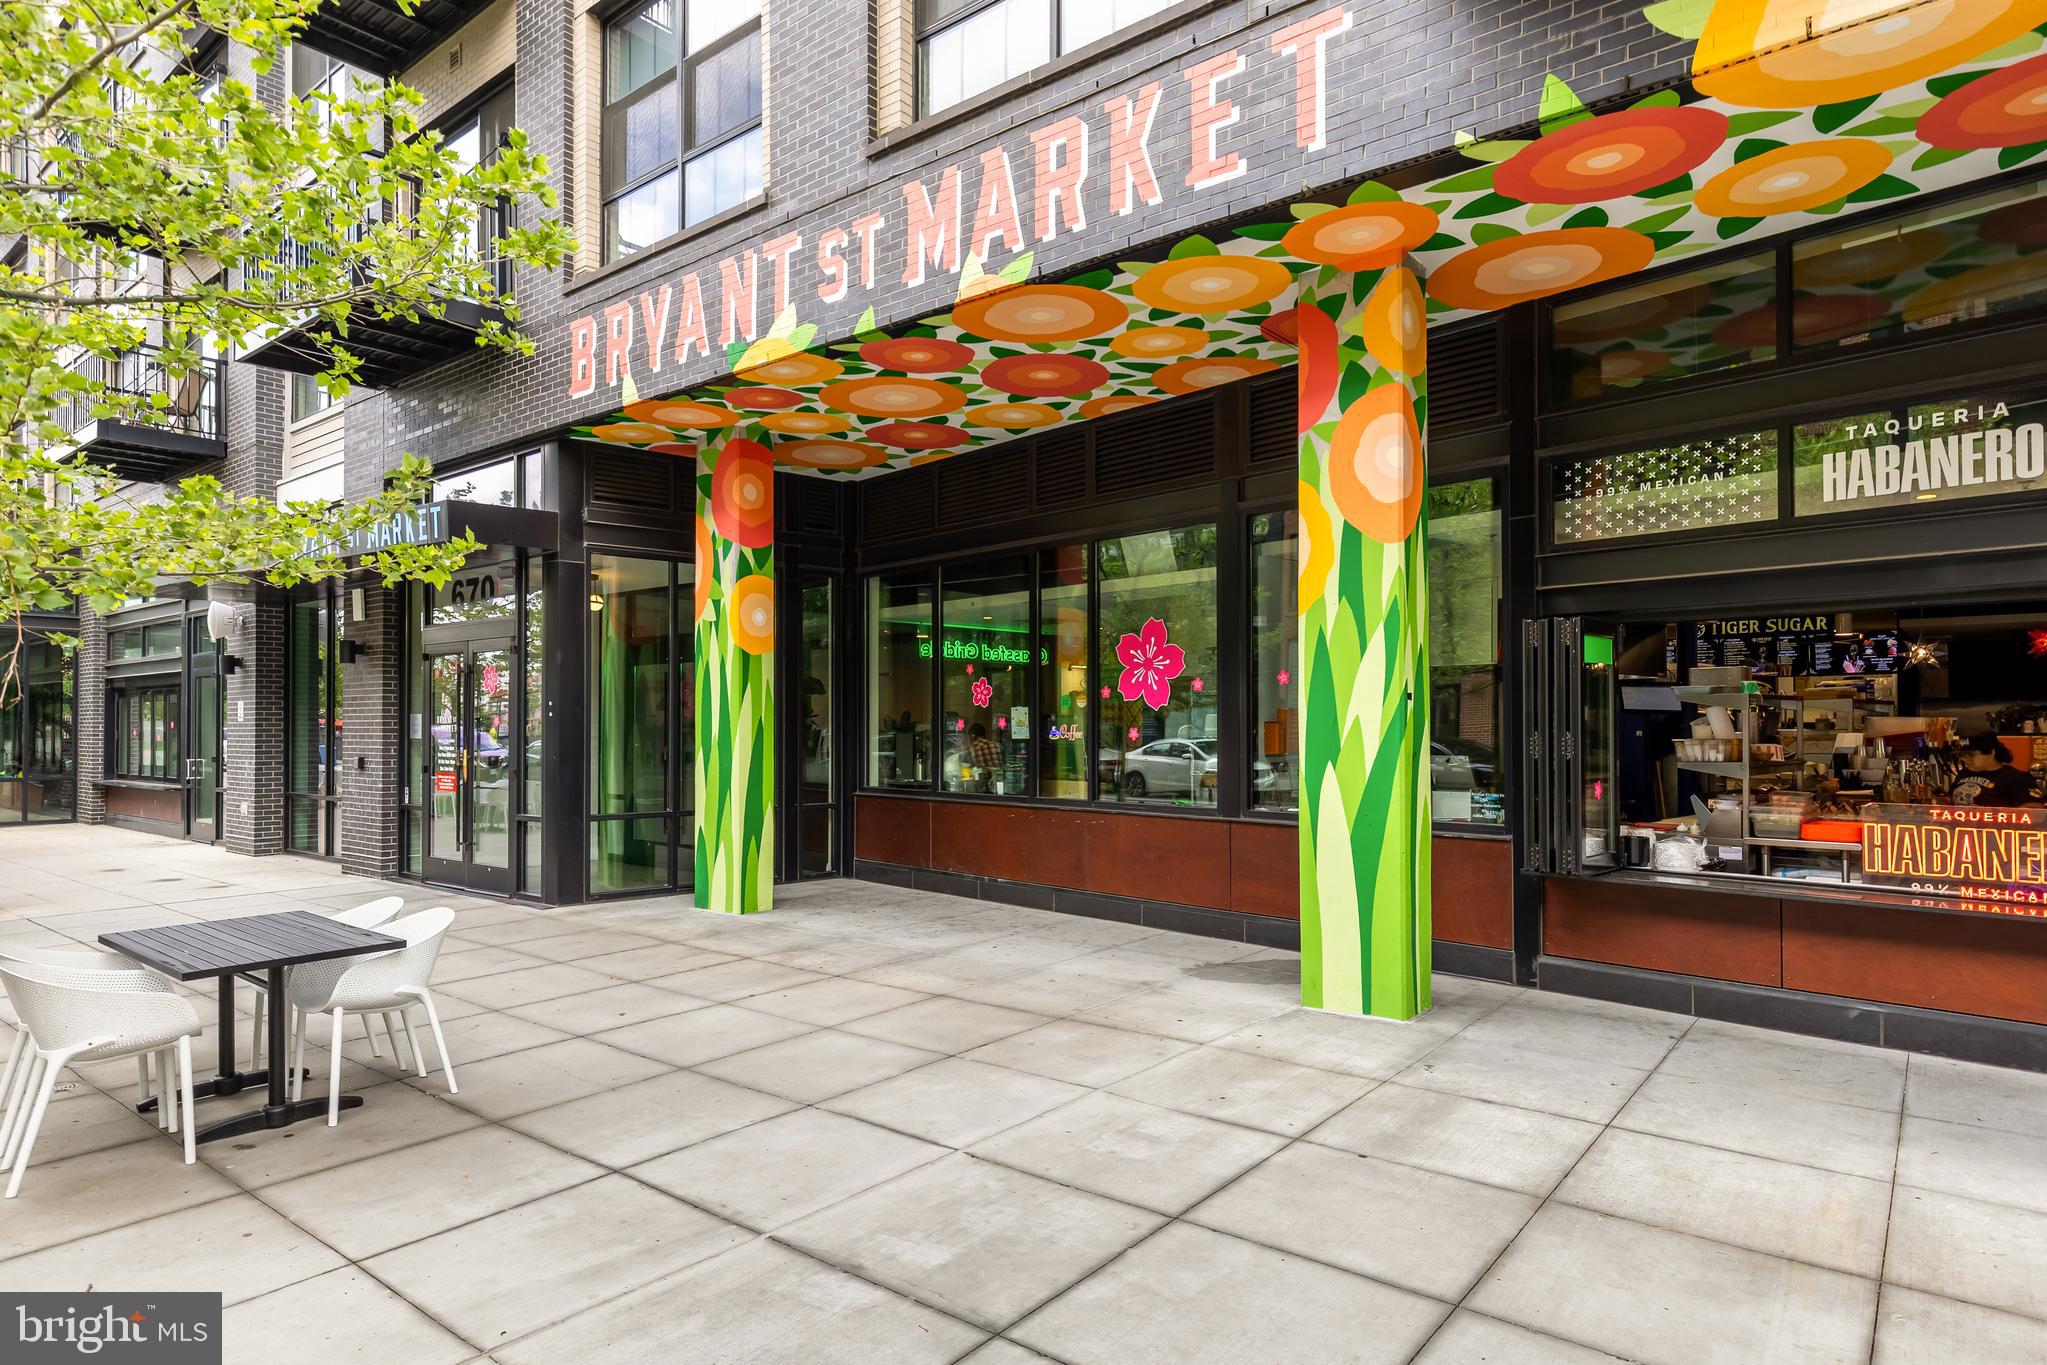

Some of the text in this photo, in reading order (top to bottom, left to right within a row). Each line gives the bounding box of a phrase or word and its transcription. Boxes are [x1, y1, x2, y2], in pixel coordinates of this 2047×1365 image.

[568, 5, 1354, 399] BRYANT ST MARKET
[1845, 402, 2010, 440] TAQUERIA
[1822, 422, 2045, 503] HABANERO
[1595, 471, 1725, 499] 99% MEXICAN
[367, 505, 441, 549] MARKET
[451, 574, 495, 604] 670
[1711, 616, 1829, 636] TIGER SUGAR
[1059, 723, 1085, 741] Coffee
[1929, 809, 2032, 825] TAQUERIA
